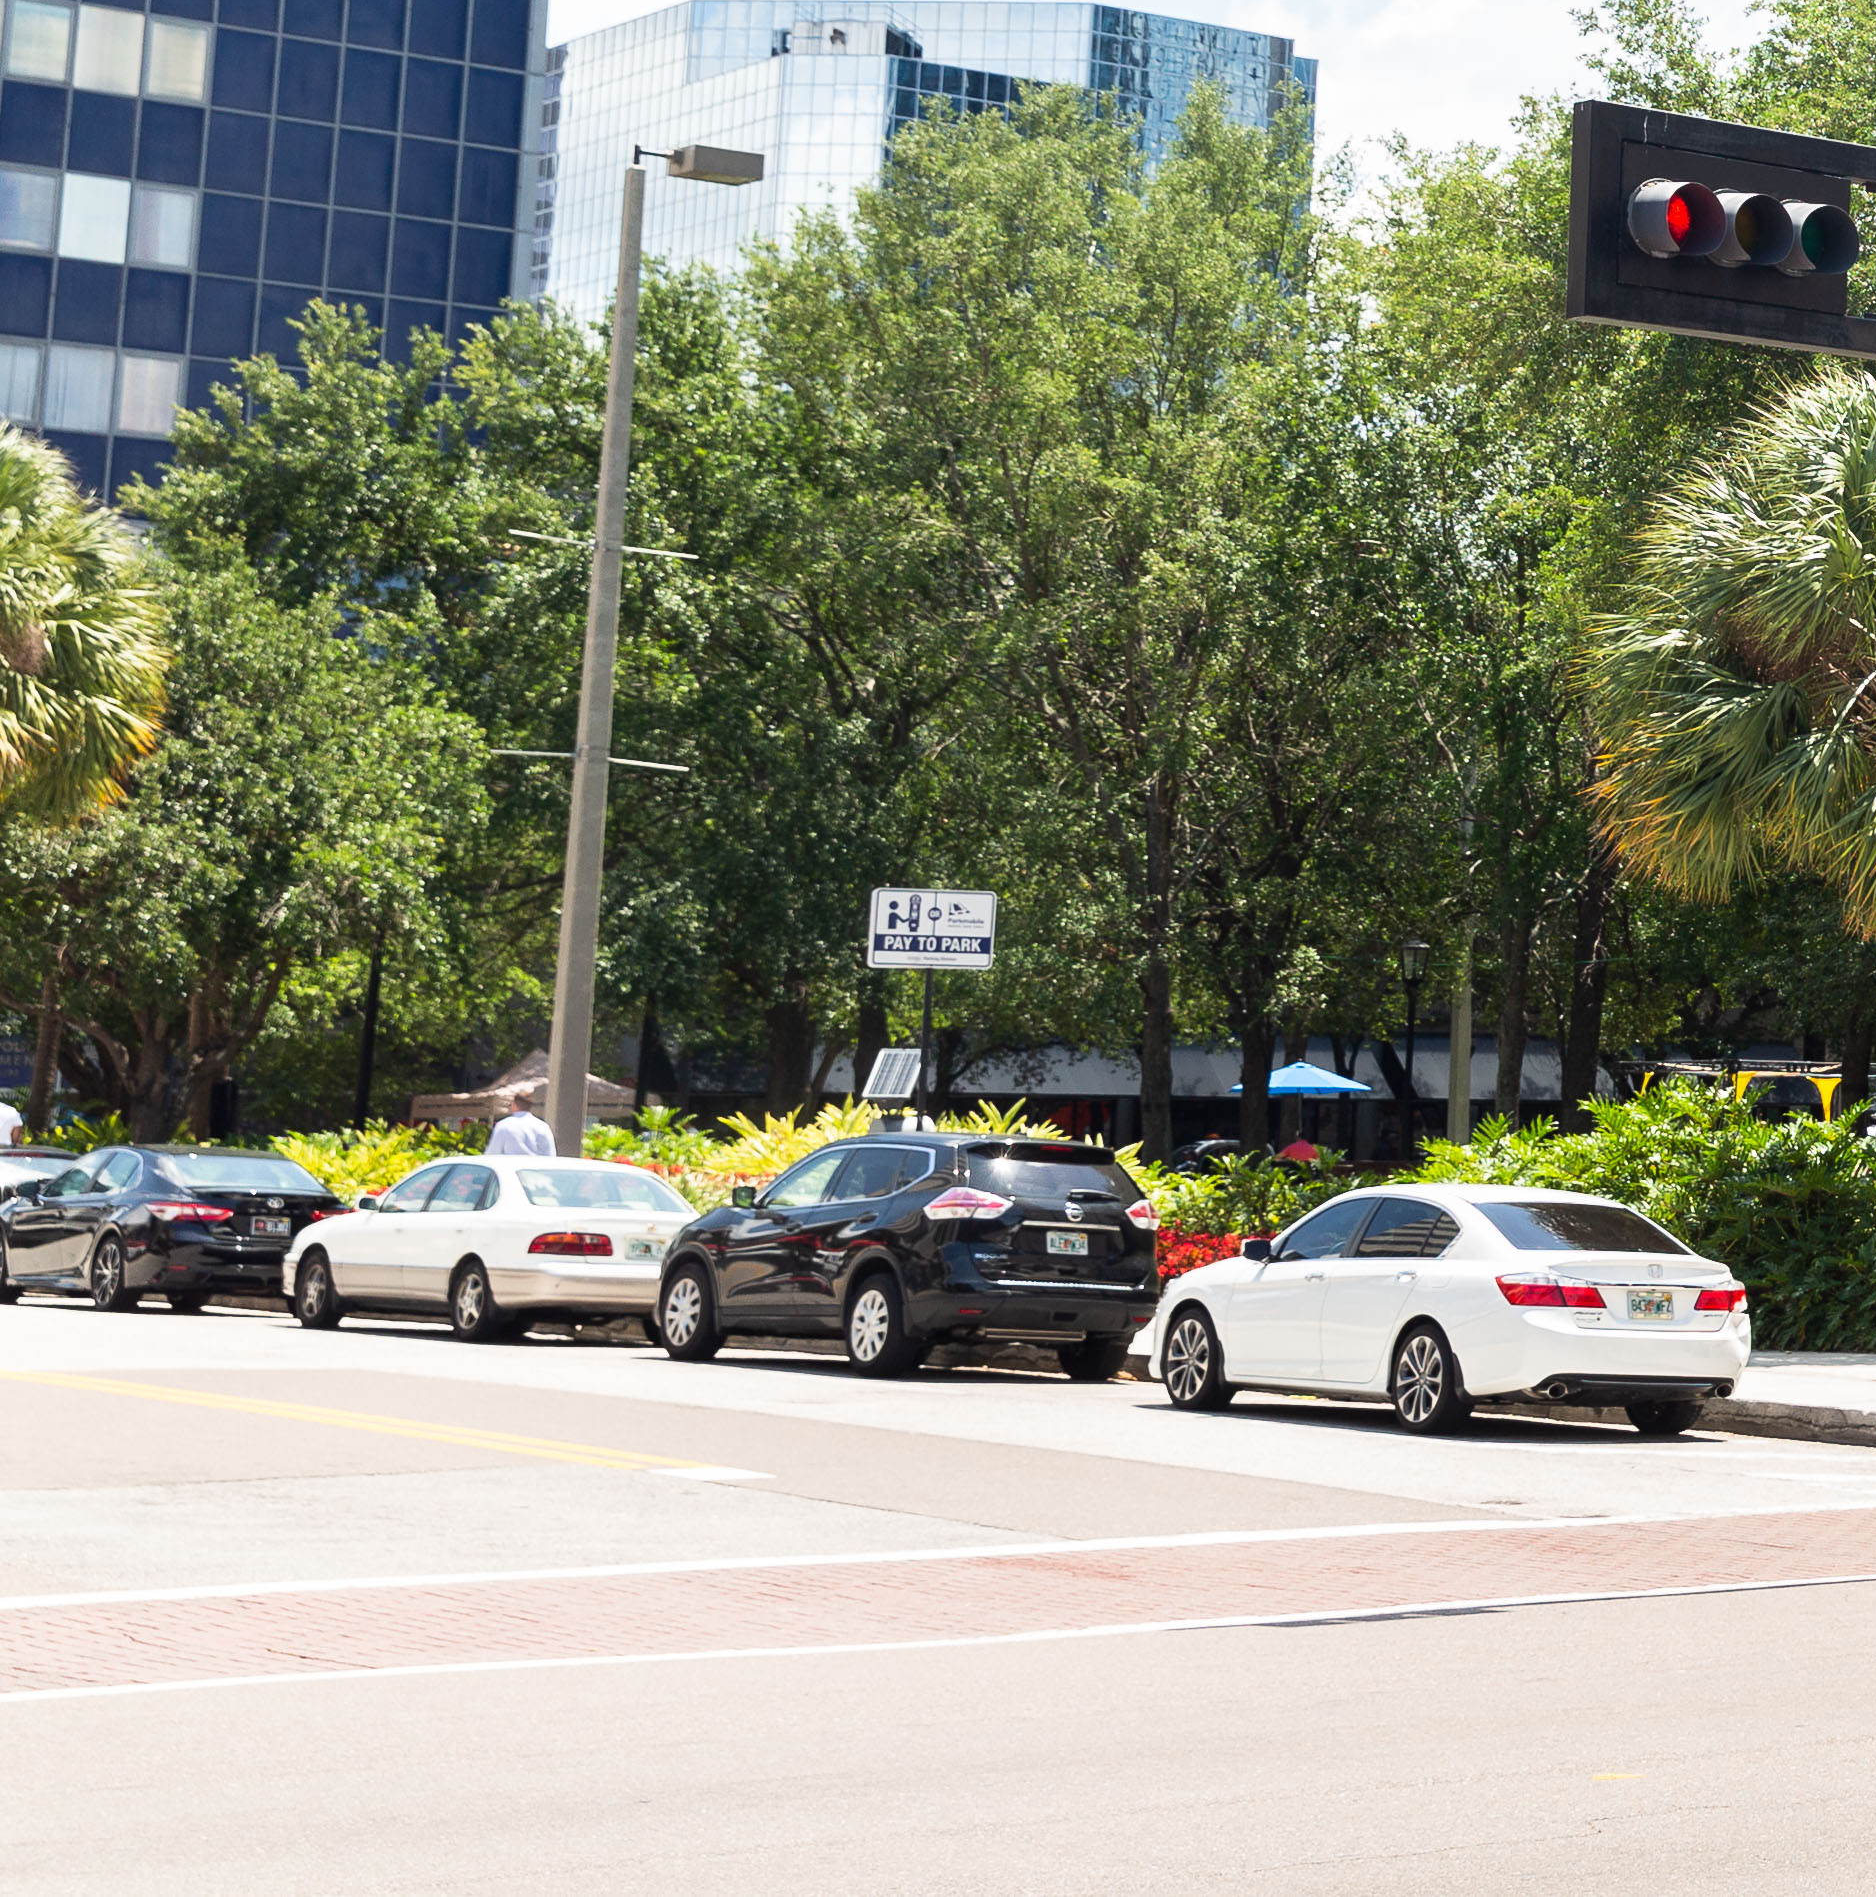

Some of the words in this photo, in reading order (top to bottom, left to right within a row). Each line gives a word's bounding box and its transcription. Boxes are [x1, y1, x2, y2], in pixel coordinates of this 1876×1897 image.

[883, 935, 913, 951] PAY
[917, 936, 937, 951] TO
[941, 937, 982, 952] PARK
